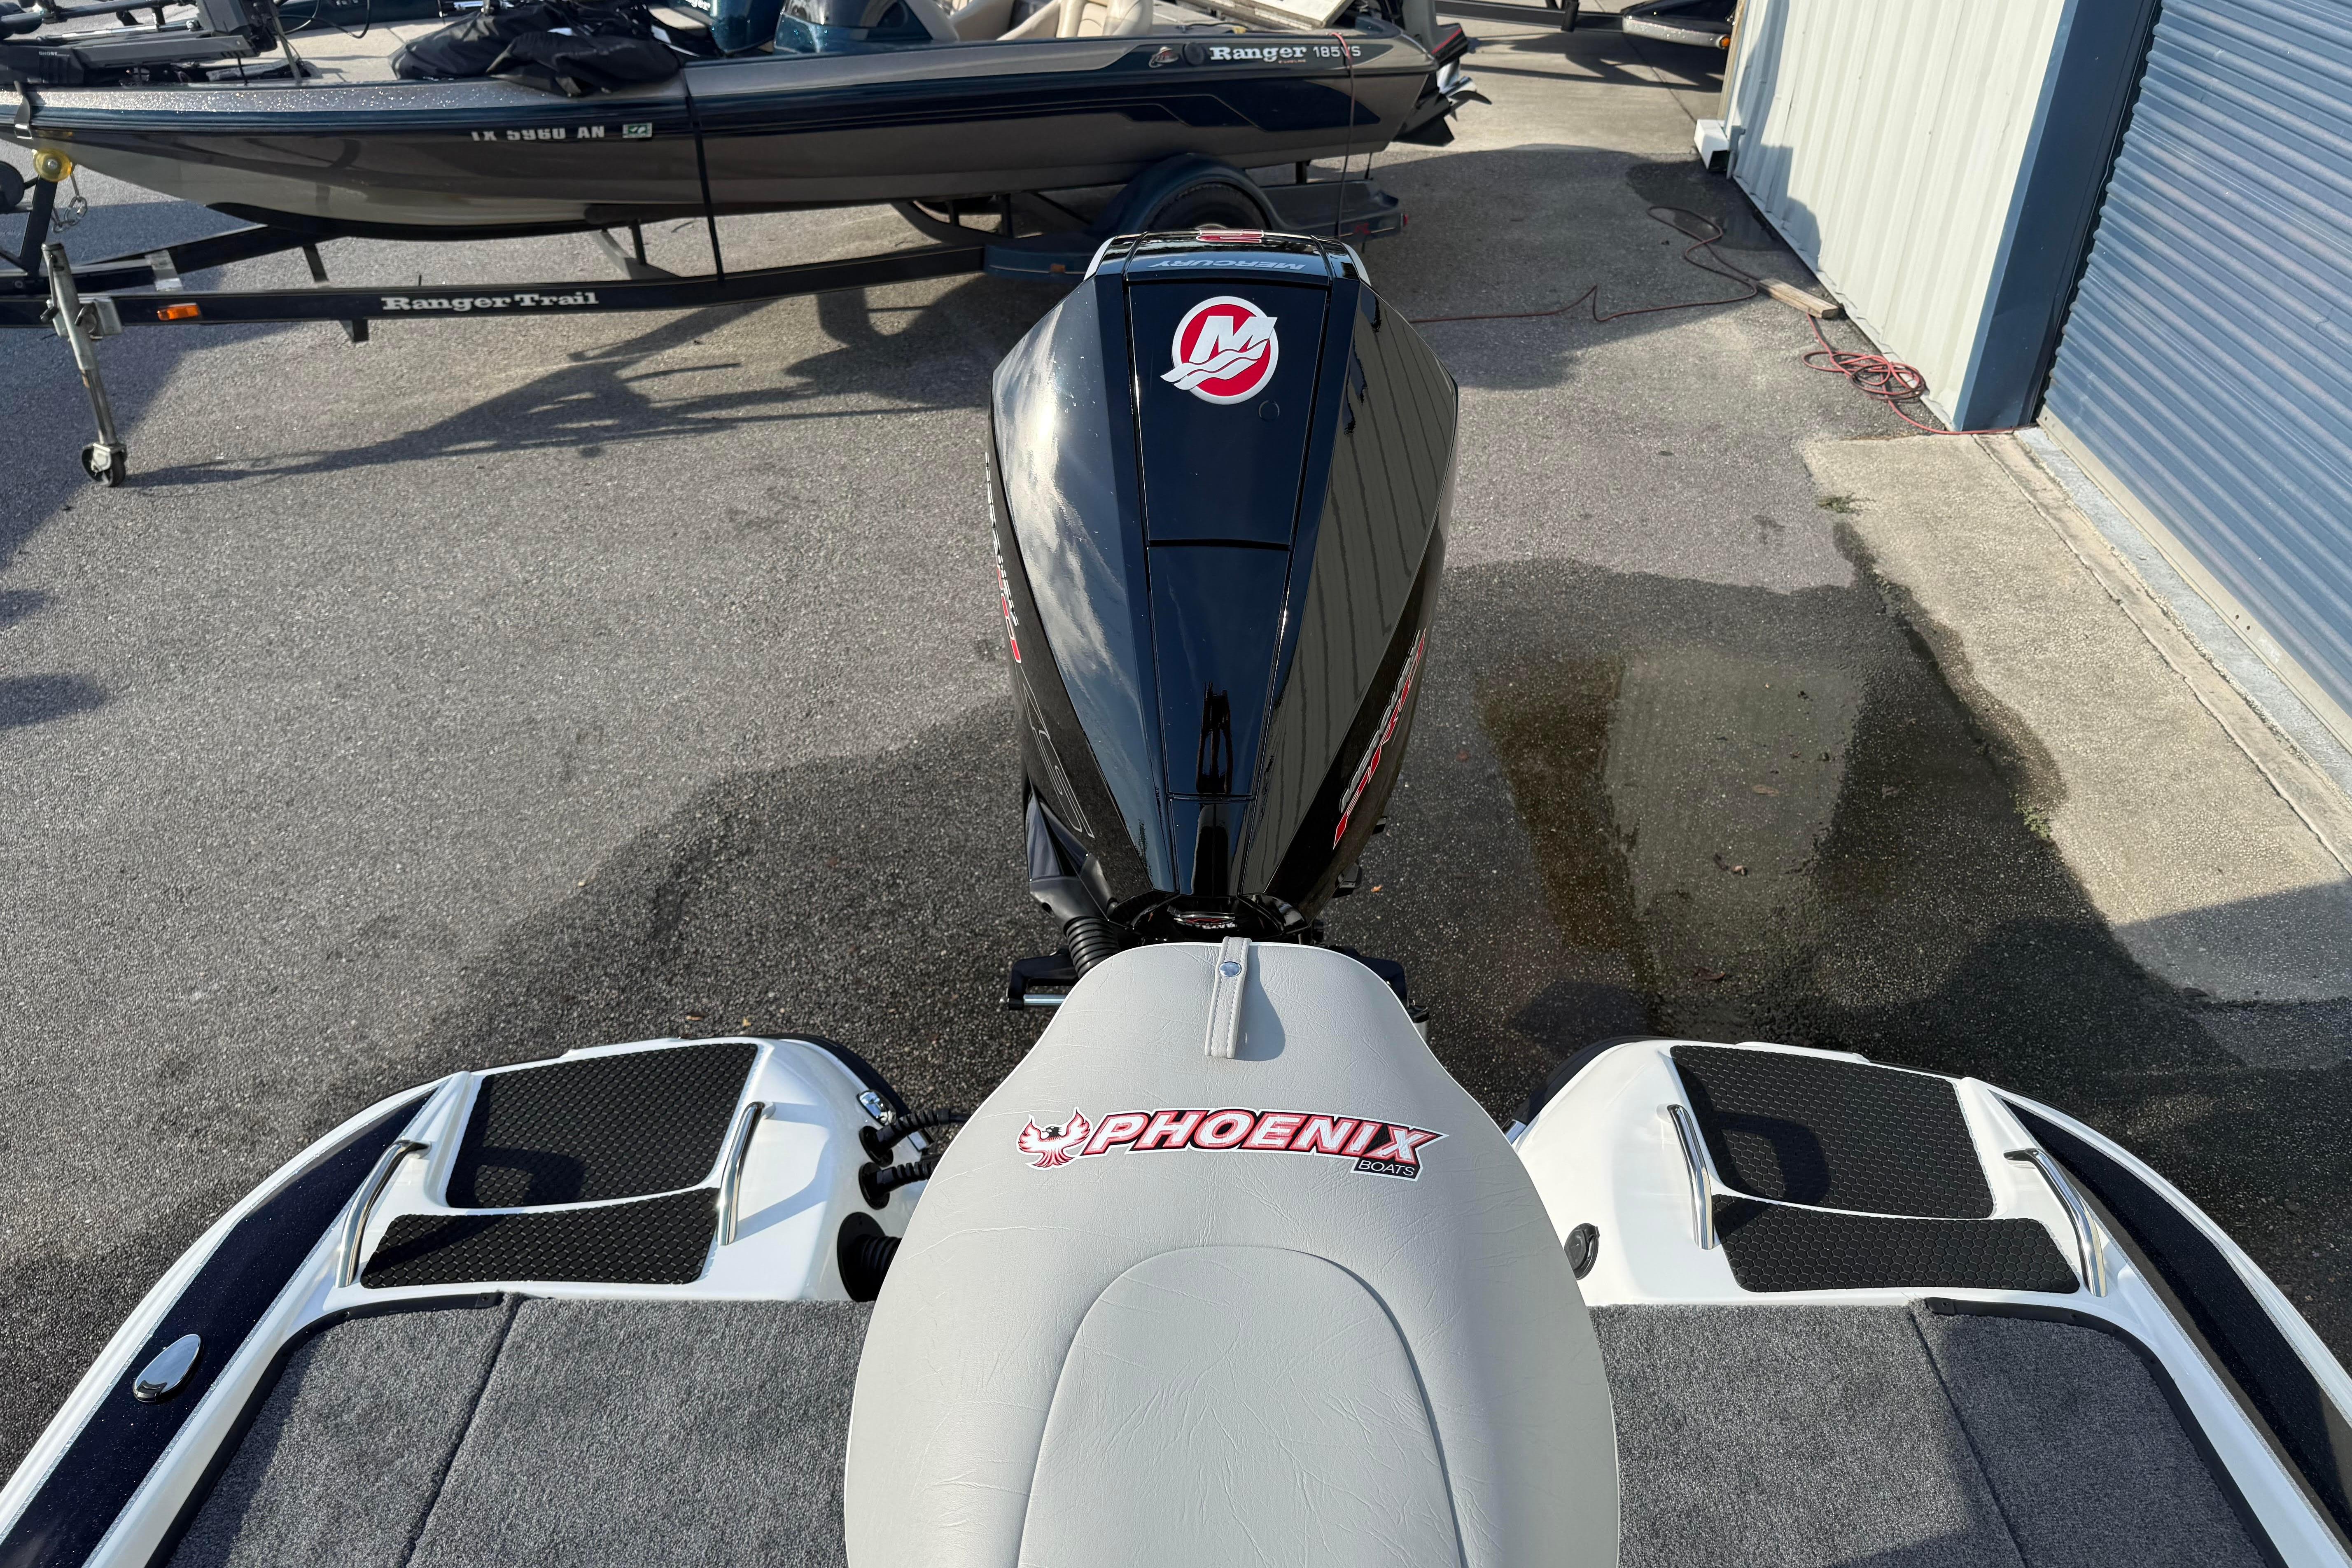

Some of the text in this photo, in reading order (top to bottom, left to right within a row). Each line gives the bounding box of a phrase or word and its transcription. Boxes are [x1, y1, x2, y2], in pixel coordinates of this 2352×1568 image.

[1210, 47, 1307, 62] Ranger
[577, 126, 605, 139] AN
[1147, 260, 1306, 270] MERCURY
[1083, 1109, 1437, 1165] PHOENIX
[1358, 1160, 1415, 1176] BOATS
